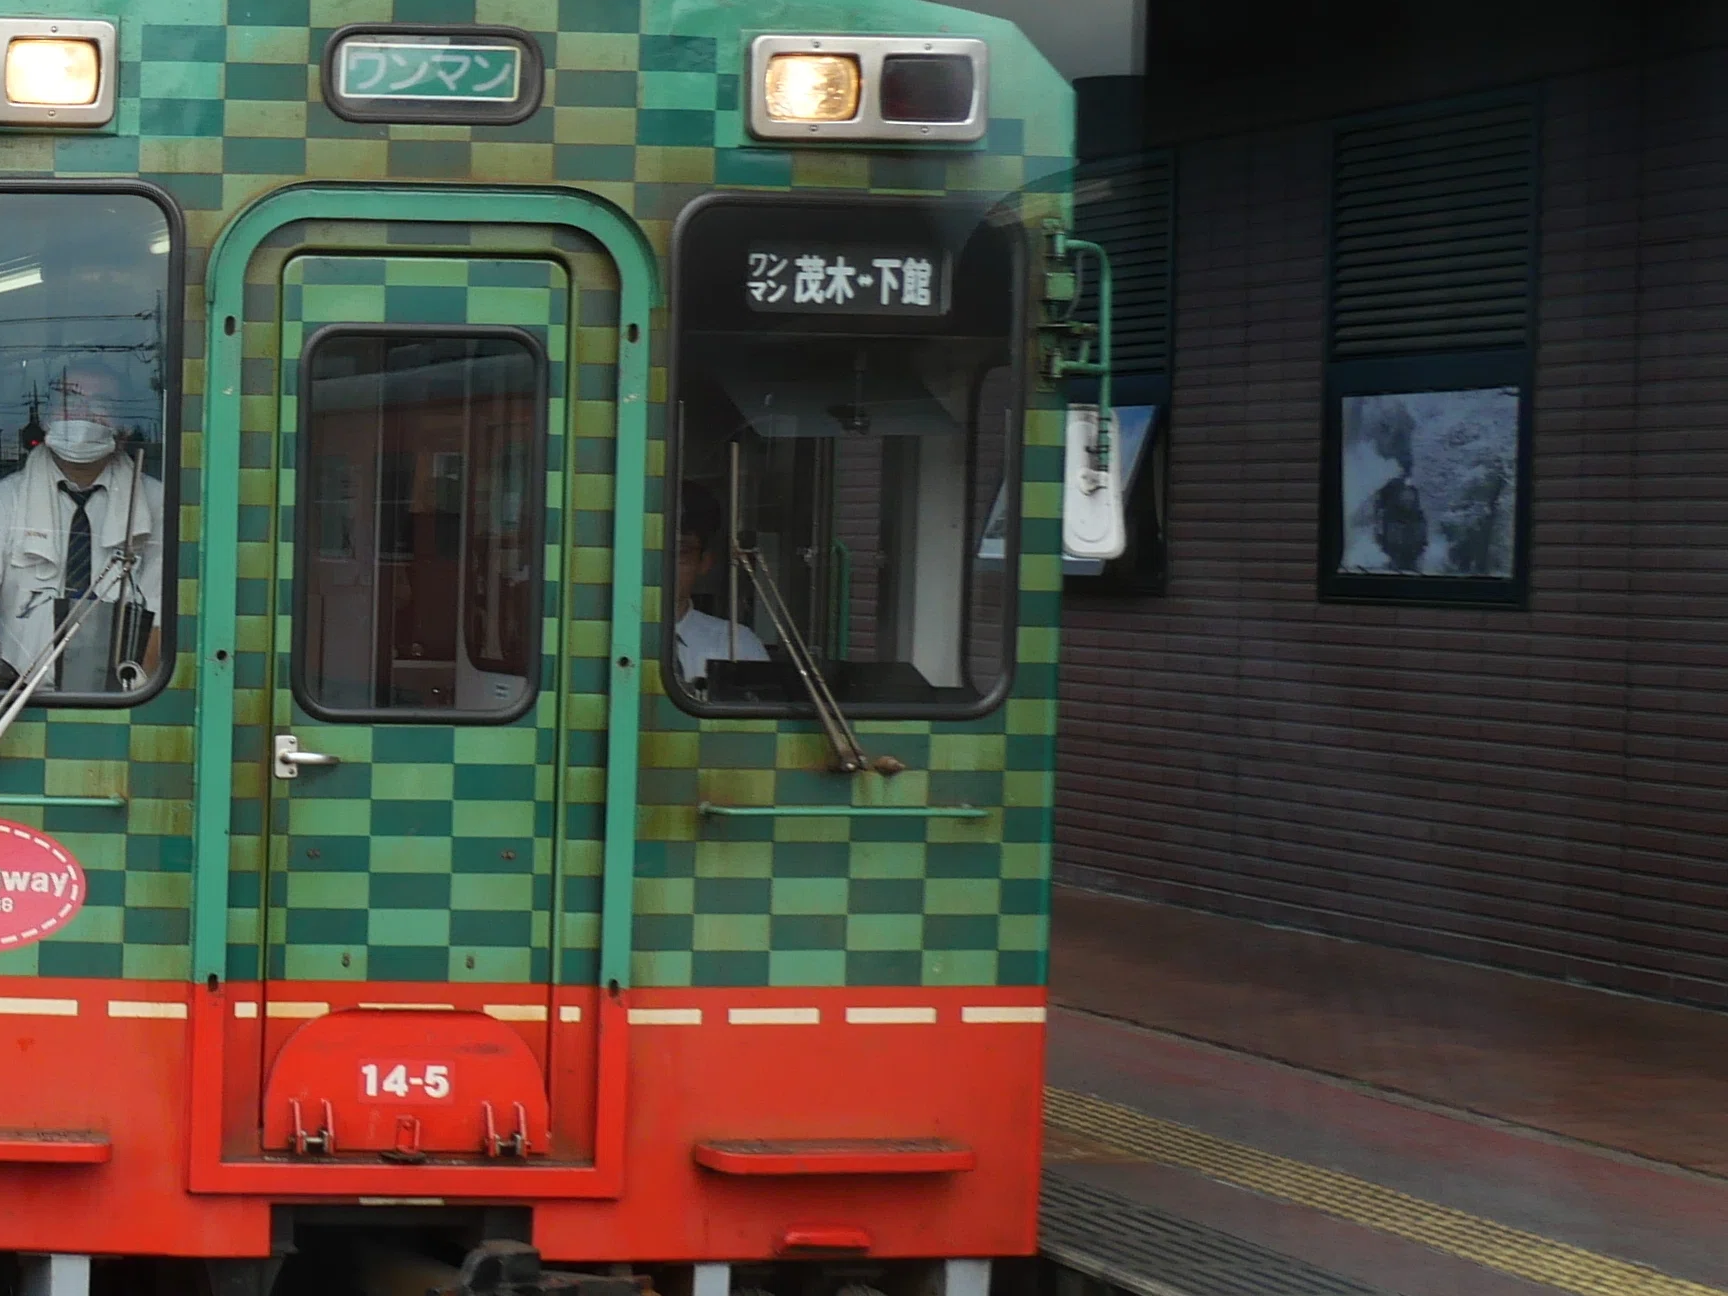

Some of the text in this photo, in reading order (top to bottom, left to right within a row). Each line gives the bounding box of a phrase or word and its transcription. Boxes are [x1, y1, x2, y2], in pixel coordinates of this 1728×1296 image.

[349, 53, 512, 92] ワンマン
[748, 253, 789, 277] ワン
[747, 280, 788, 303] マン
[361, 1064, 450, 1099] 14-5
